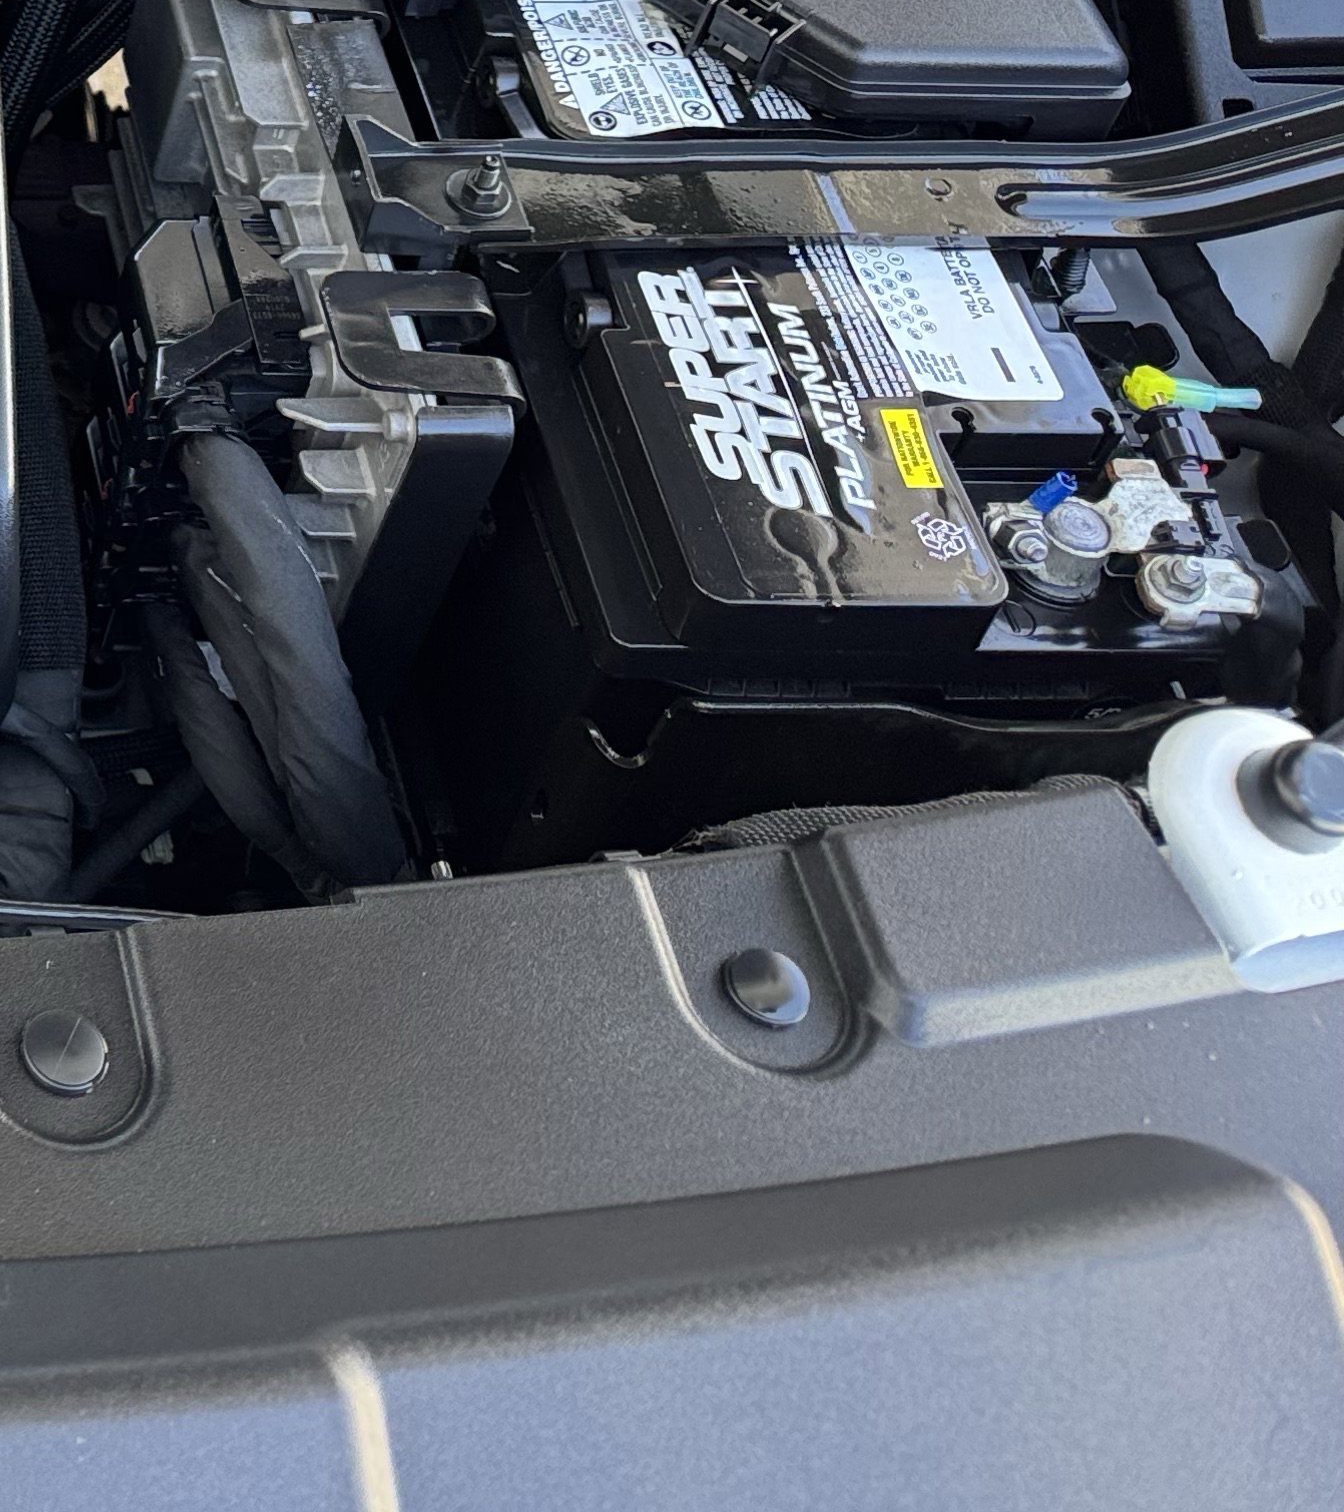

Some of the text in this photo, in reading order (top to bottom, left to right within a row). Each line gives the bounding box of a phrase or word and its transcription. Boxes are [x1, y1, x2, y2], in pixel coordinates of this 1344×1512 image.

[614, 67, 648, 124] EXPLOSIVE GASES
[957, 289, 984, 319] VRLA
[963, 271, 985, 293] NOT
[977, 297, 995, 313] DO
[637, 271, 765, 485] SUPER
[677, 266, 833, 517] START
[767, 302, 877, 510] PLATINUM
